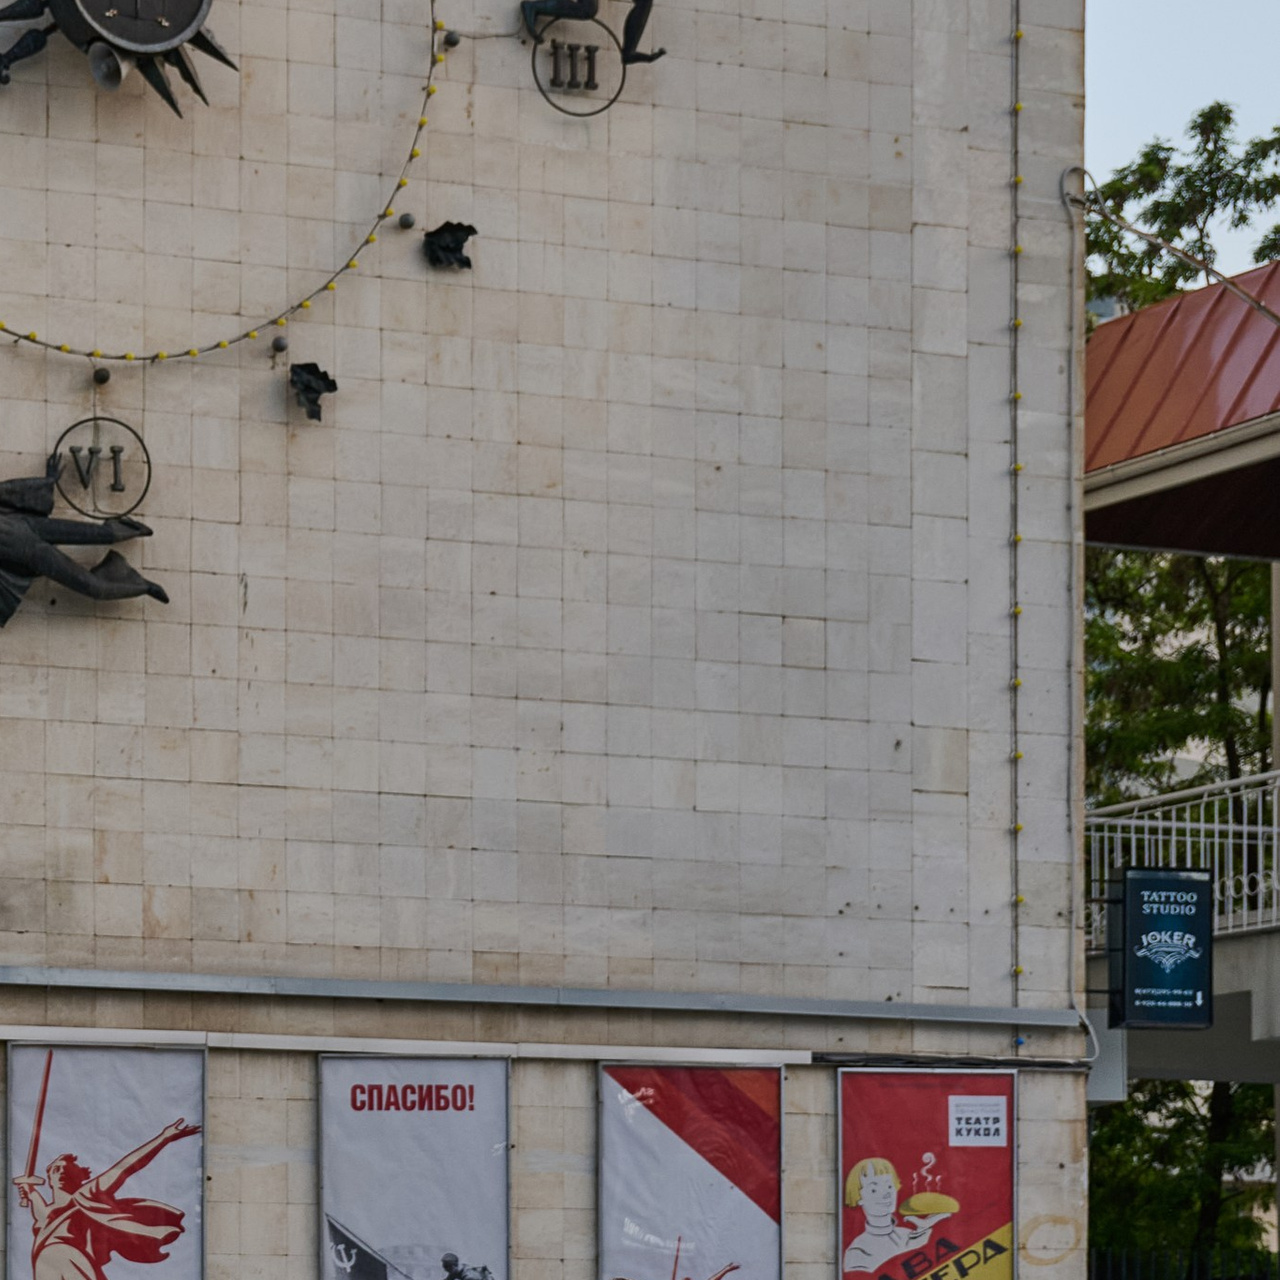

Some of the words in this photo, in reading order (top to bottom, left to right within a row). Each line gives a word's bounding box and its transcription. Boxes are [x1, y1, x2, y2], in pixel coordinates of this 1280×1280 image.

[550, 42, 599, 90] III
[69, 446, 124, 492] VI
[1140, 890, 1198, 903] TATTOO
[1142, 903, 1196, 915] STUDIO
[1141, 931, 1197, 948] JOKER
[350, 1084, 475, 1111] СПАСИБО!
[955, 1116, 1000, 1125] ТЕАТР
[955, 1127, 1000, 1137] КУКОЛ
